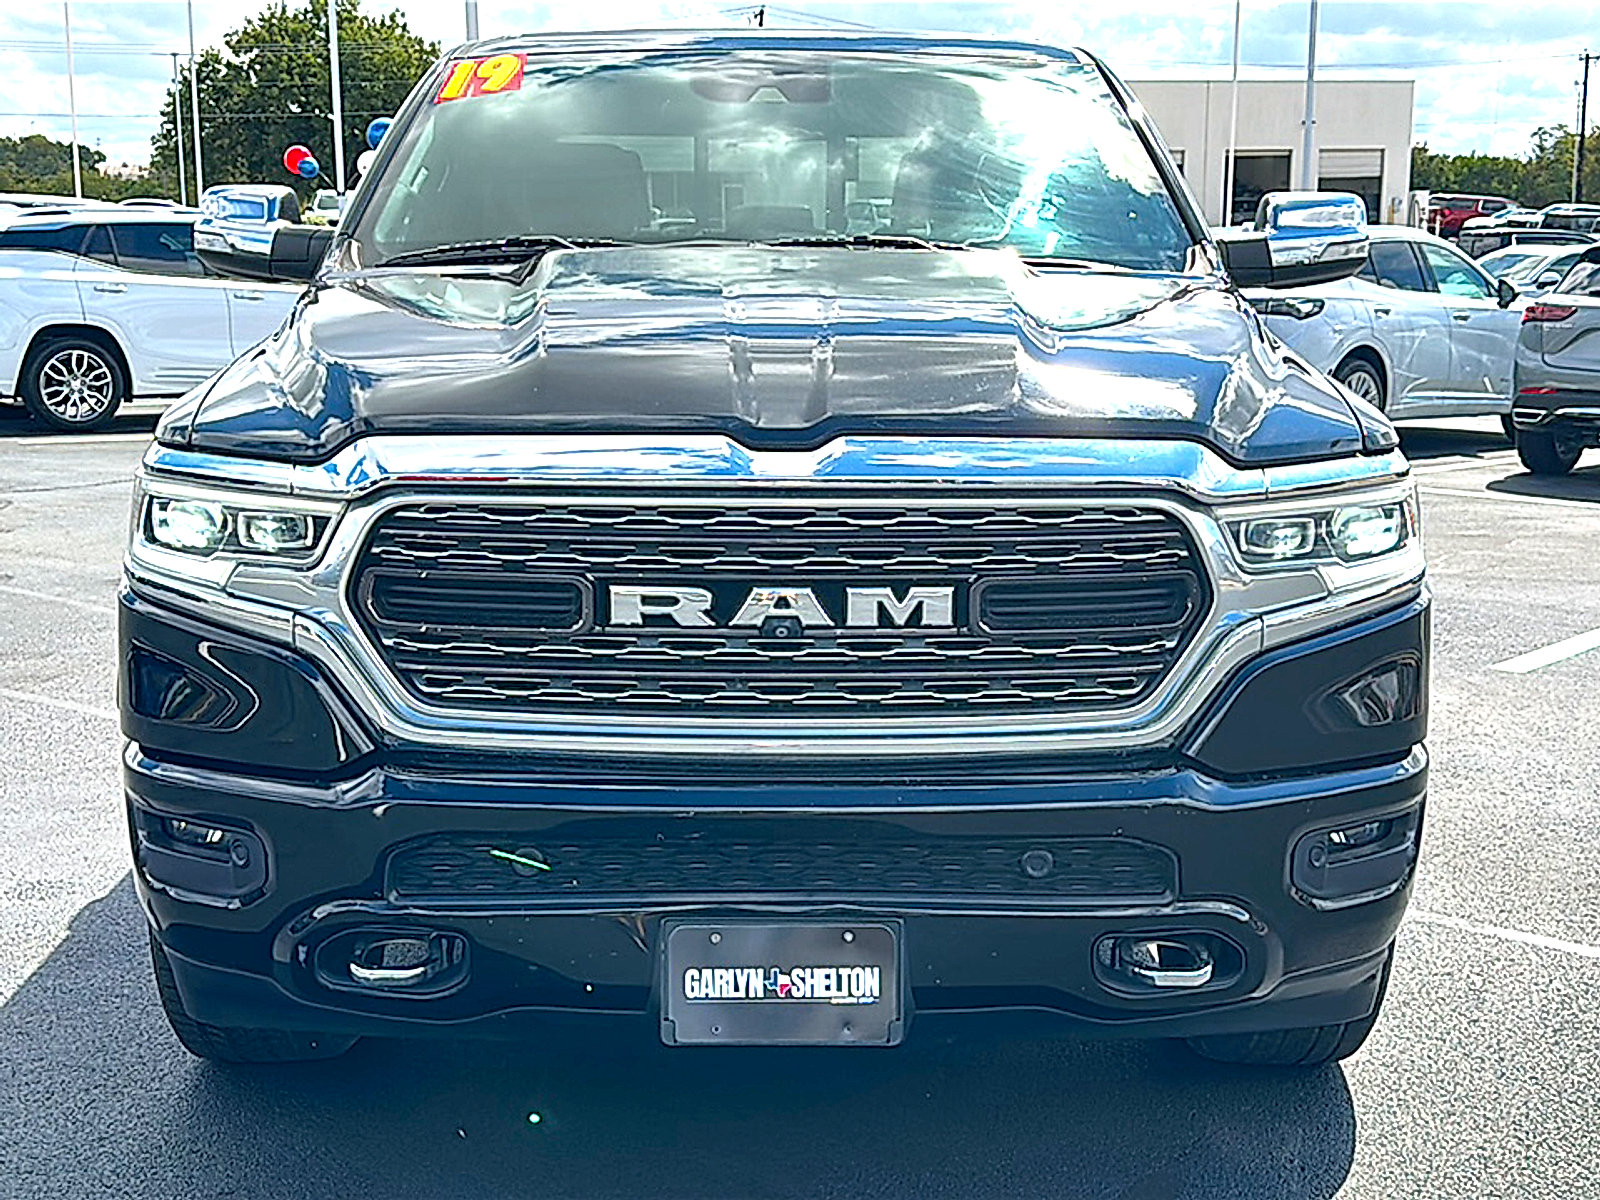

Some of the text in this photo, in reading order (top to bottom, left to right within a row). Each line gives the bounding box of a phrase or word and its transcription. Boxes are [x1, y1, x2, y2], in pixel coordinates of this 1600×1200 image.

[439, 53, 521, 98] 19
[608, 585, 955, 627] RAM
[684, 966, 881, 999] GARLYN SHELTON
